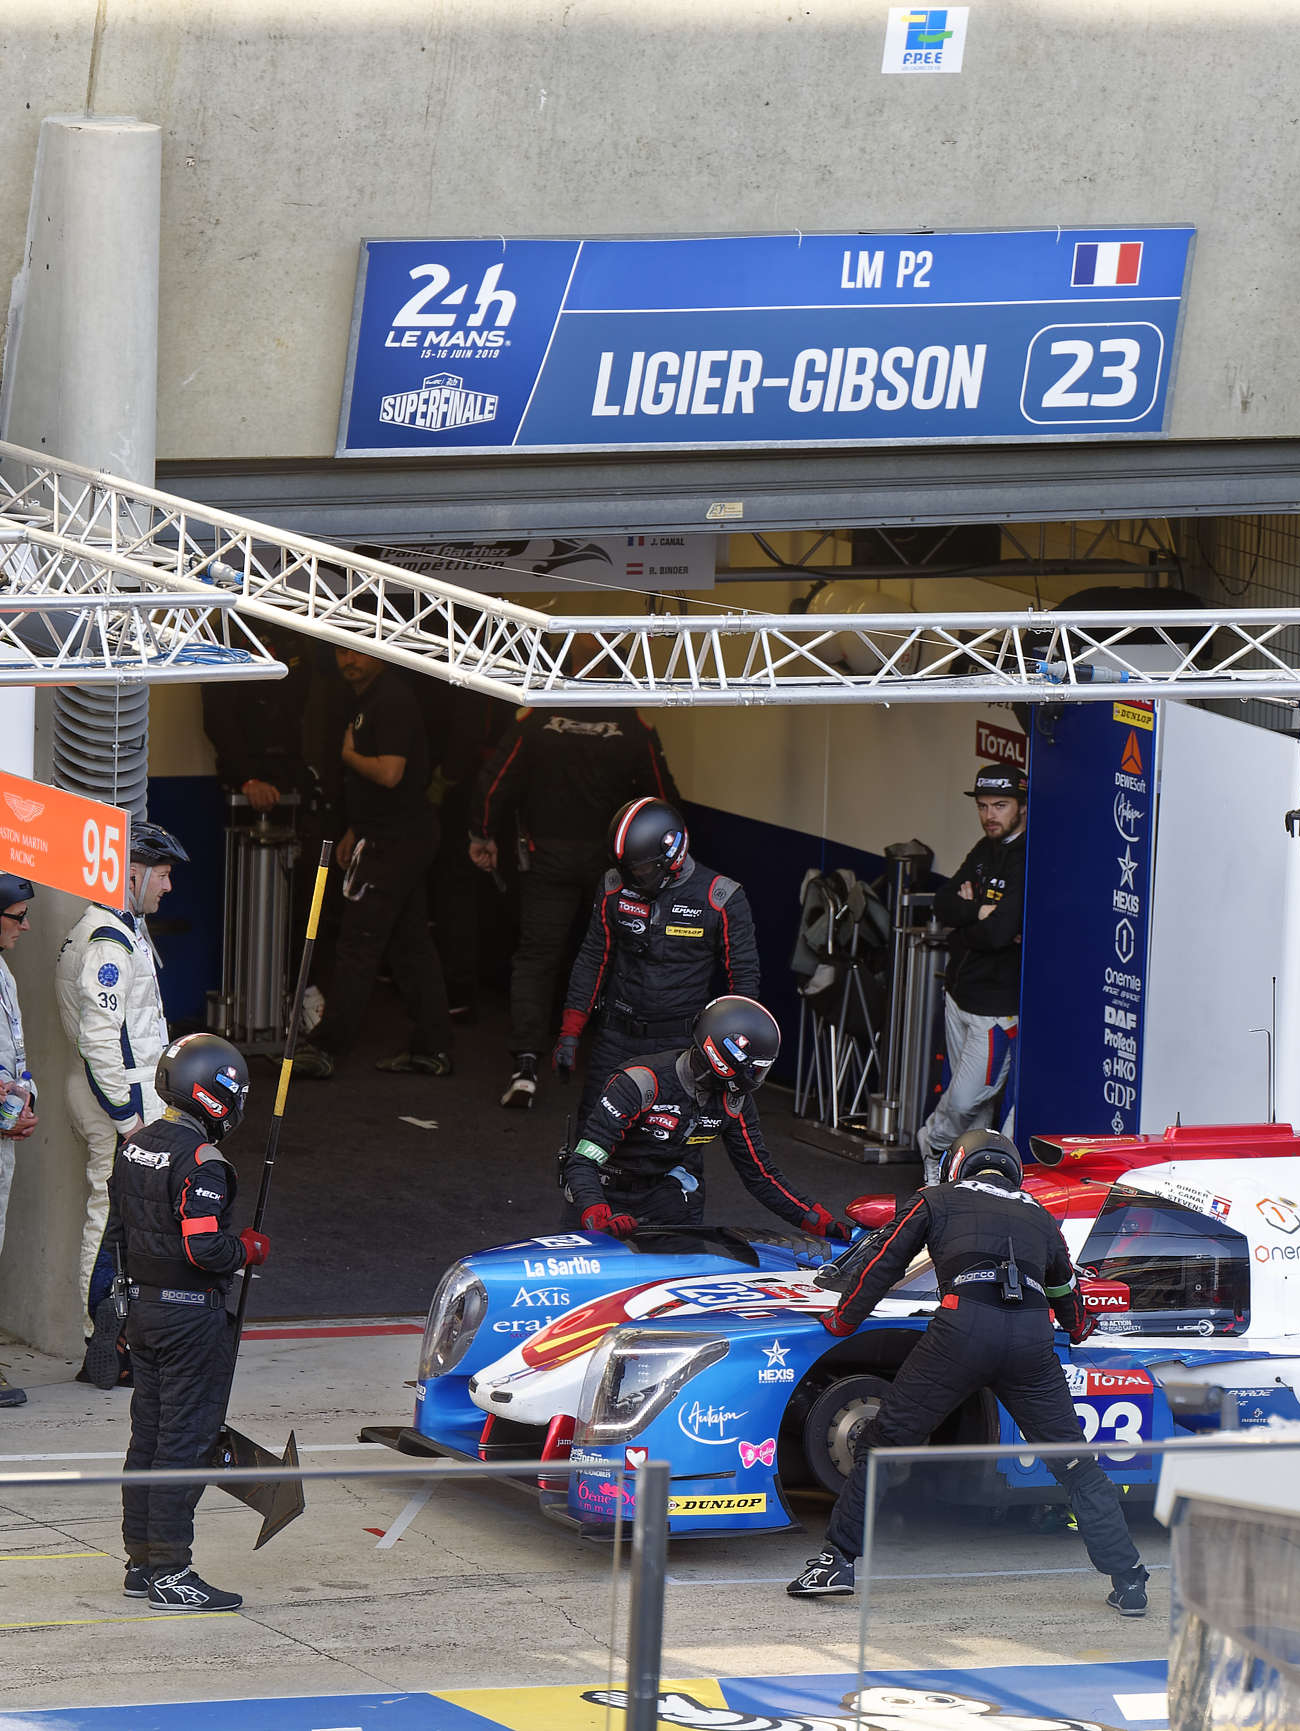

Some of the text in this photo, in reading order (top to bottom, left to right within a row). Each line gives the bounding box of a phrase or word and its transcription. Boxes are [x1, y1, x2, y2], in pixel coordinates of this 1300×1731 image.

[841, 250, 934, 288] LM P2
[392, 263, 517, 327] 24h
[385, 331, 418, 348] LE
[475, 349, 500, 359] 2019
[591, 338, 1141, 417] LIGIER-GIBSON 23
[382, 388, 496, 430] SUPERFINALE
[978, 727, 1025, 764] TOTAL
[22, 834, 48, 855] MARTIN
[10, 847, 36, 868] RACING
[82, 818, 120, 893] 95
[1113, 889, 1140, 914] HEXIS
[97, 992, 118, 1011] 39
[1104, 1005, 1137, 1030] DAF
[1103, 1080, 1137, 1110] GDP
[524, 1257, 600, 1278] La Sarthe
[511, 1286, 571, 1307] Axis
[758, 1368, 795, 1381] HEXIS
[1090, 1372, 1150, 1386] TOTAL
[683, 1496, 762, 1511] DUNLOP
